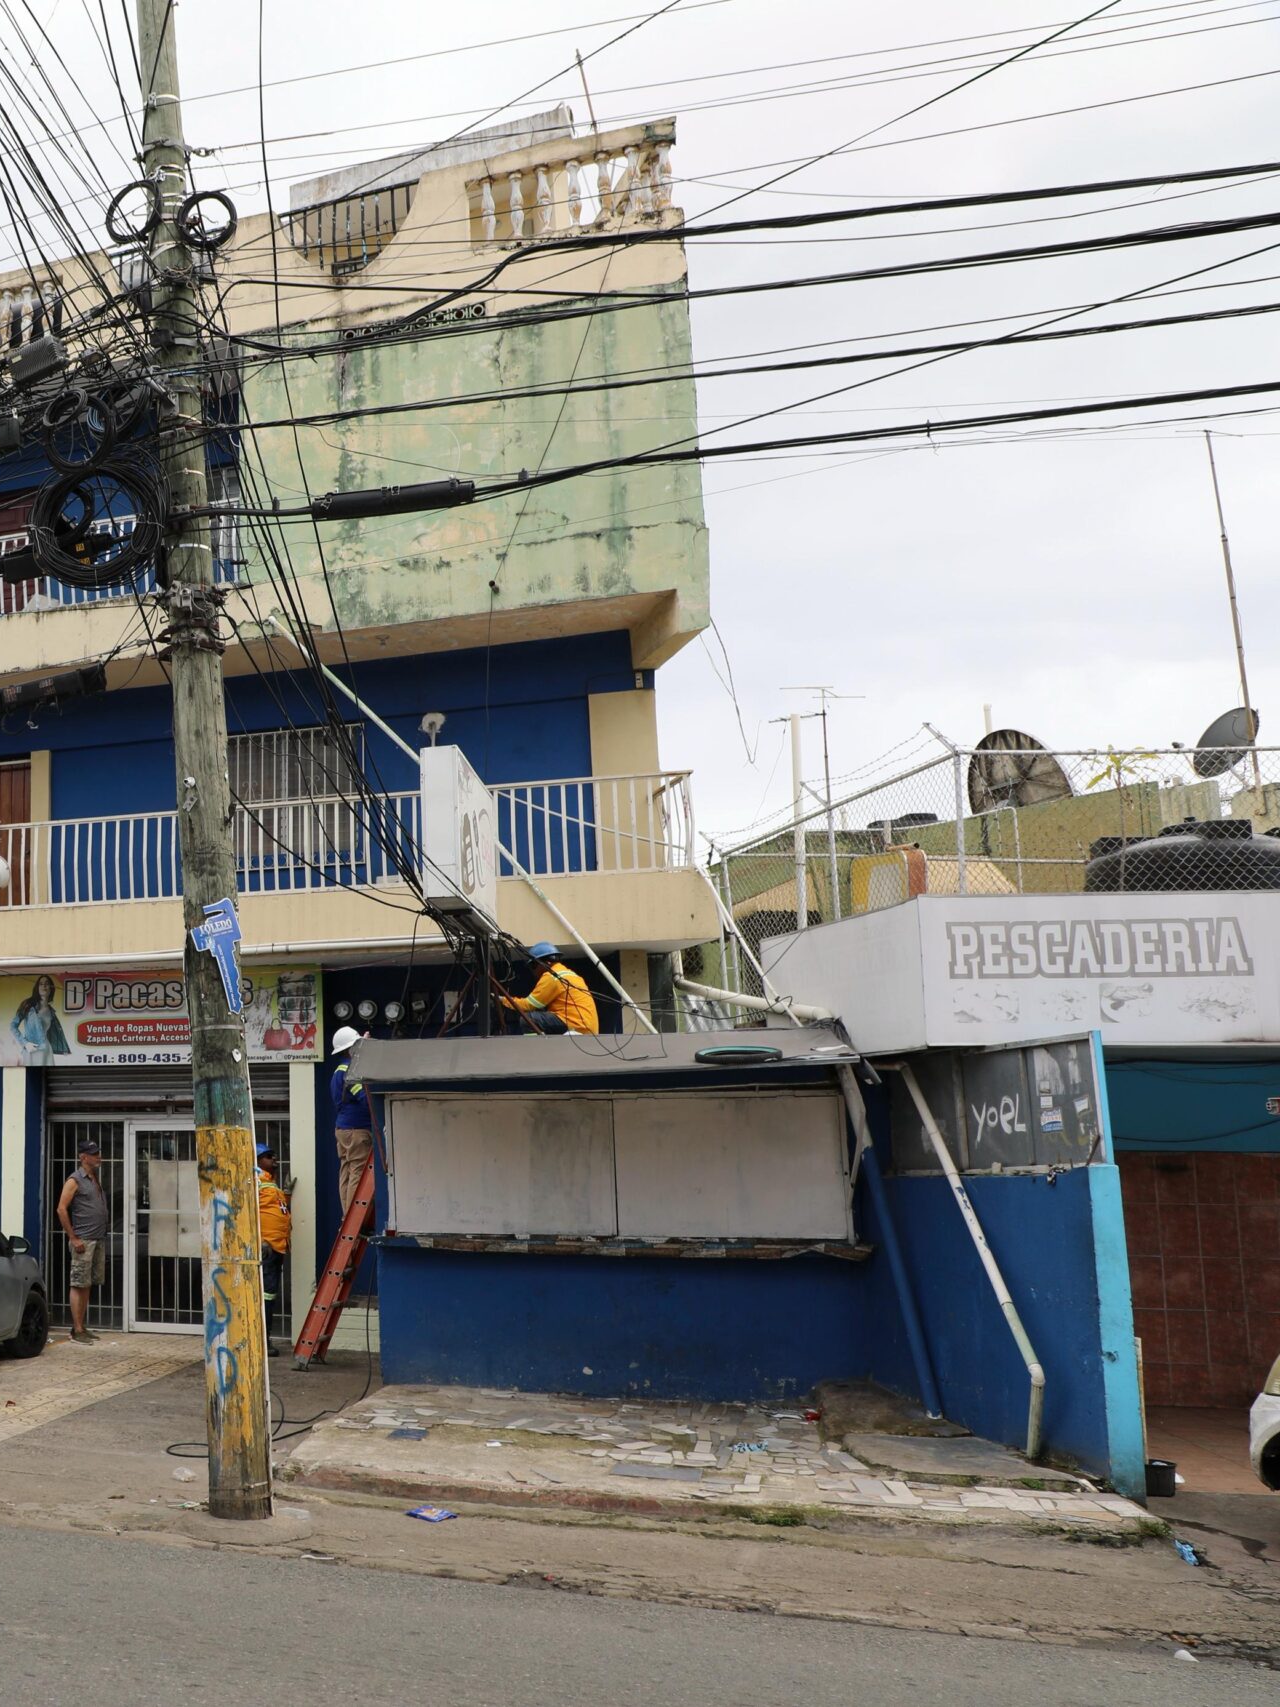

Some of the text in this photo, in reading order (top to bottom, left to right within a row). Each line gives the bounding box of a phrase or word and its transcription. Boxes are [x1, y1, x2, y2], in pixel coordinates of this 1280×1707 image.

[200, 919, 233, 935] TOLEDO
[945, 917, 1255, 979] PESCADERIA
[64, 978, 184, 1012] D' Pacas
[86, 1023, 188, 1034] Venta de Ropas Nuevas
[86, 1035, 120, 1044] Zapatos,
[122, 1034, 158, 1042] Carteras,
[87, 1054, 114, 1063] Tel.:
